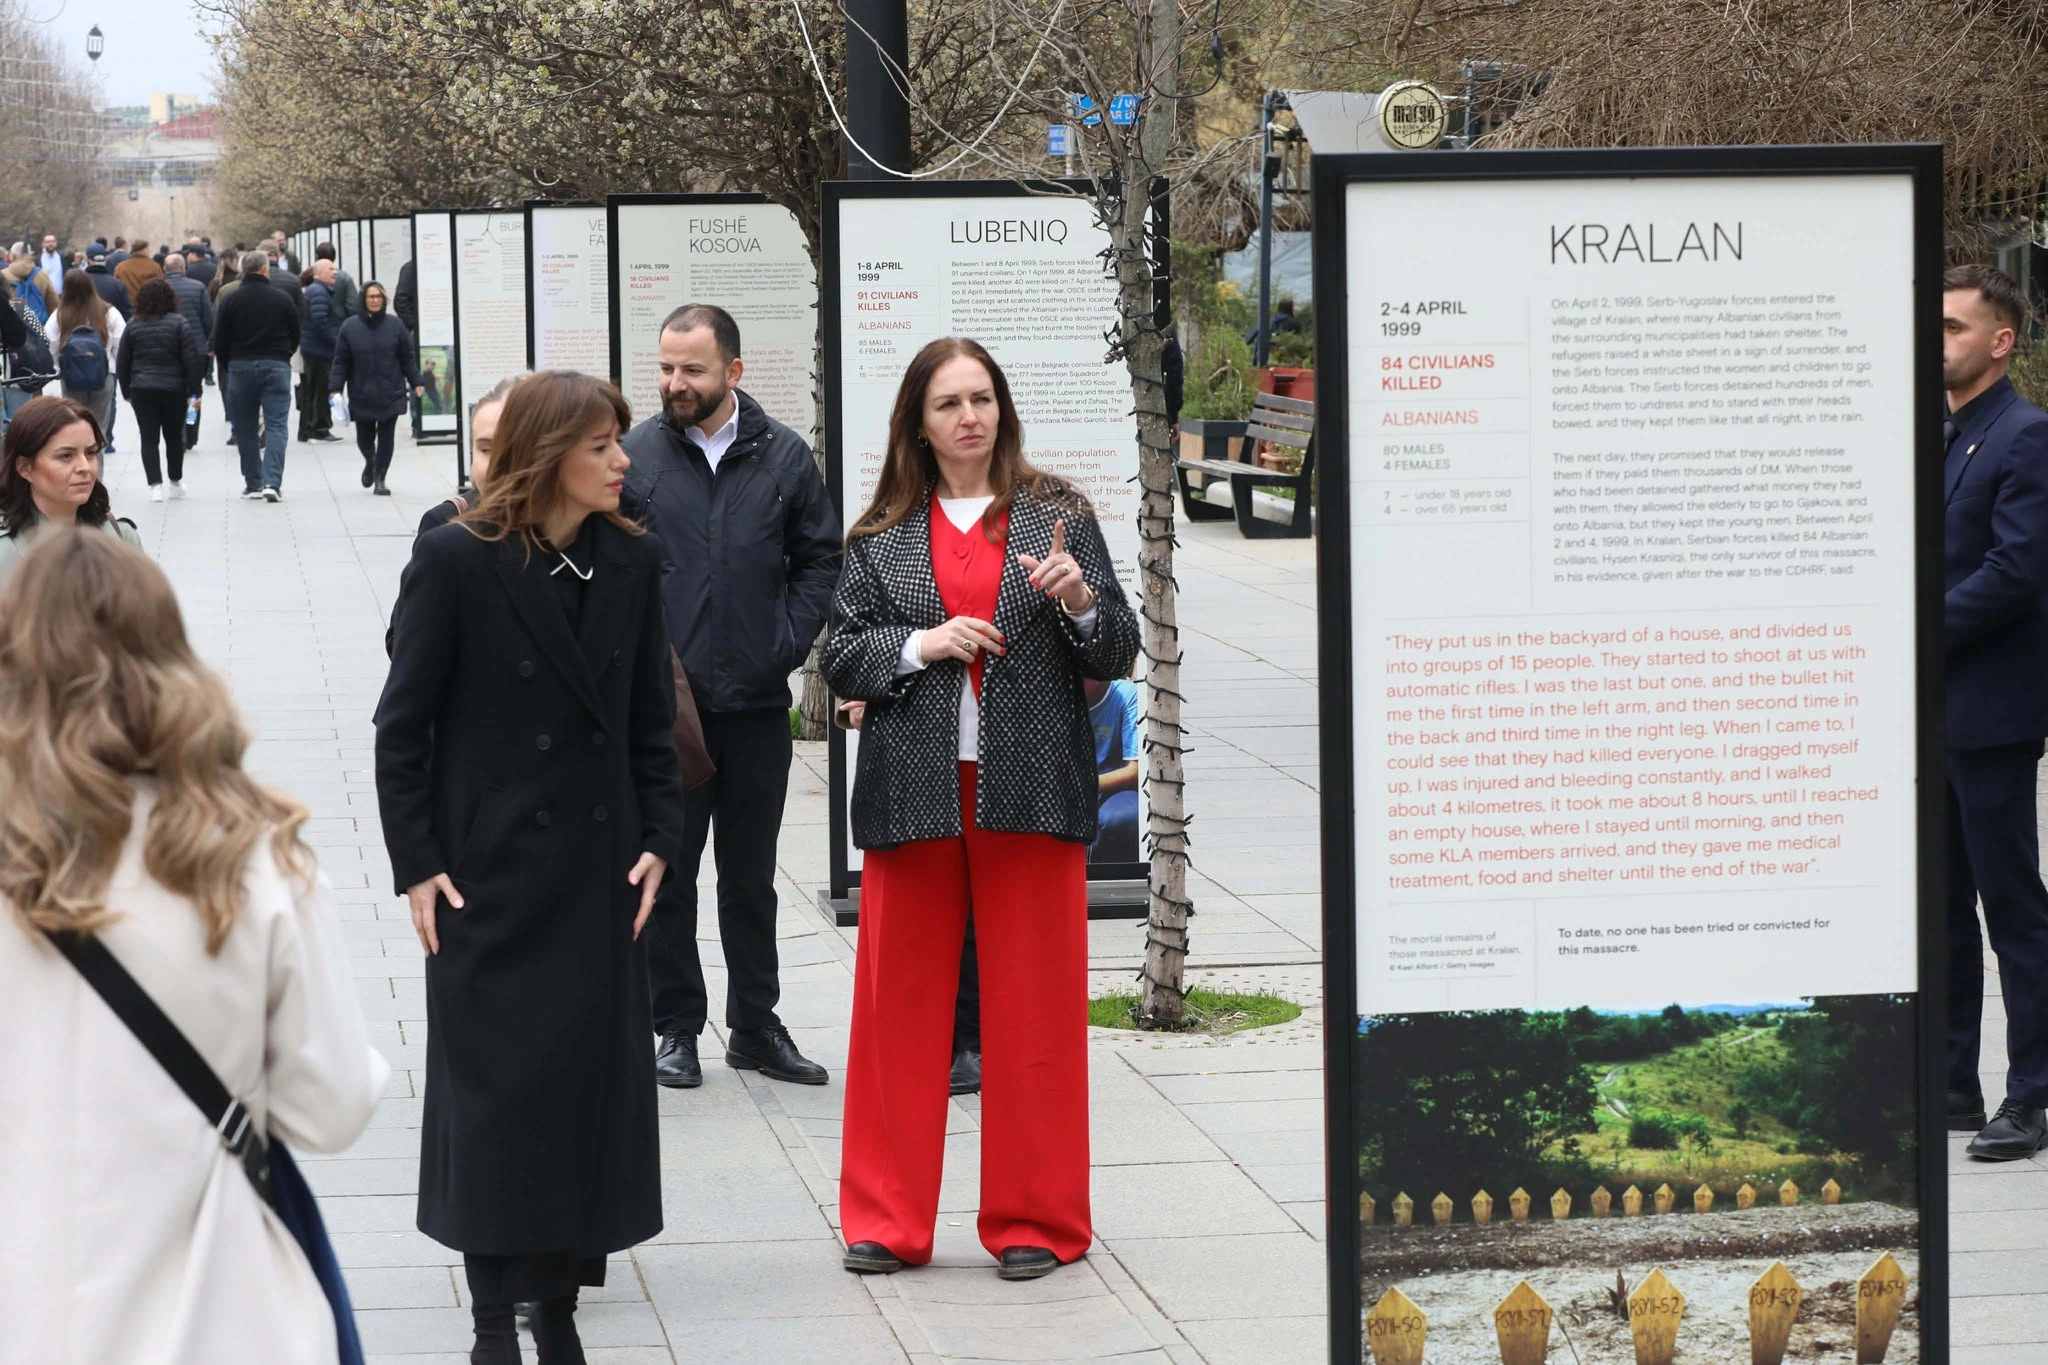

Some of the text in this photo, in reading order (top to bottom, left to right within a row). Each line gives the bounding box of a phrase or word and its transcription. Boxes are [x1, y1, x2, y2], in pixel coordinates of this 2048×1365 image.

[689, 215, 747, 234] FUSHË
[950, 219, 1067, 246] LUBENIQ
[689, 237, 762, 253] KOSOVA
[1551, 222, 1742, 264] KRALAN
[857, 261, 903, 270] 1-8 APRIL
[857, 273, 879, 281] 1999
[857, 290, 918, 300] 91 CIVILIANS
[1551, 297, 1569, 310] On
[1571, 297, 1598, 310] April
[1731, 293, 1767, 305] forces
[1769, 293, 1814, 304] entered
[1816, 294, 1835, 304] the
[857, 302, 890, 310] KILLES
[1380, 300, 1467, 316] 2-4 APRIL
[1039, 314, 1058, 322] OSCE
[1551, 315, 1587, 328] village
[1590, 313, 1602, 325] of
[1645, 313, 1680, 324] where
[1682, 314, 1714, 325] many
[1716, 311, 1766, 323] Albanian
[1768, 311, 1812, 322] civilians
[1815, 309, 1841, 320] from
[857, 320, 911, 330] ALBANIANS
[1381, 321, 1421, 336] 1999
[1381, 354, 1494, 371] 84 CIVILIANS
[1382, 375, 1442, 390] KILLED
[1382, 410, 1478, 426] ALBANIANS
[1031, 448, 1118, 458] civilian population.
[1383, 443, 1444, 456] 80 MALES
[1079, 462, 1100, 470] from
[1383, 458, 1450, 470] 4 FEMALES
[1099, 474, 1120, 483] their
[1094, 486, 1132, 496] of those
[1414, 489, 1446, 500] under
[1463, 490, 1492, 501] years
[1494, 487, 1512, 498] old
[1099, 500, 1111, 508] be
[1383, 504, 1391, 515] 4
[1458, 504, 1488, 515] years
[1489, 502, 1507, 512] old
[1438, 634, 1466, 652] put
[1472, 635, 1492, 648] us
[1496, 631, 1511, 646] in
[1517, 631, 1544, 646] the
[1550, 628, 1626, 648] backyard
[1631, 626, 1648, 643] of
[1654, 630, 1664, 642] a
[1669, 626, 1724, 641] house,
[1729, 624, 1760, 640] and
[1766, 622, 1827, 638] divided
[1833, 624, 1852, 636] us
[1386, 645, 1865, 677] into groups of 15 people. They started to shoot at us with
[1386, 682, 1470, 698] automatic
[1475, 678, 1519, 695] rifles.
[1533, 681, 1565, 693] was
[1570, 677, 1598, 692] the
[1603, 676, 1632, 691] last
[1638, 674, 1665, 690] but
[1670, 676, 1706, 689] one,
[1711, 672, 1743, 688] and
[1748, 671, 1776, 686] the
[1781, 669, 1827, 685] bullet
[1833, 669, 1854, 683] hit
[1557, 917, 1830, 938] To date, no one has been tried or convicted for
[1388, 931, 1496, 944] The mortal remains of
[1388, 950, 1417, 959] those
[1419, 948, 1473, 957] massacred
[1475, 947, 1485, 956] at
[1558, 944, 1639, 955] this massacre.
